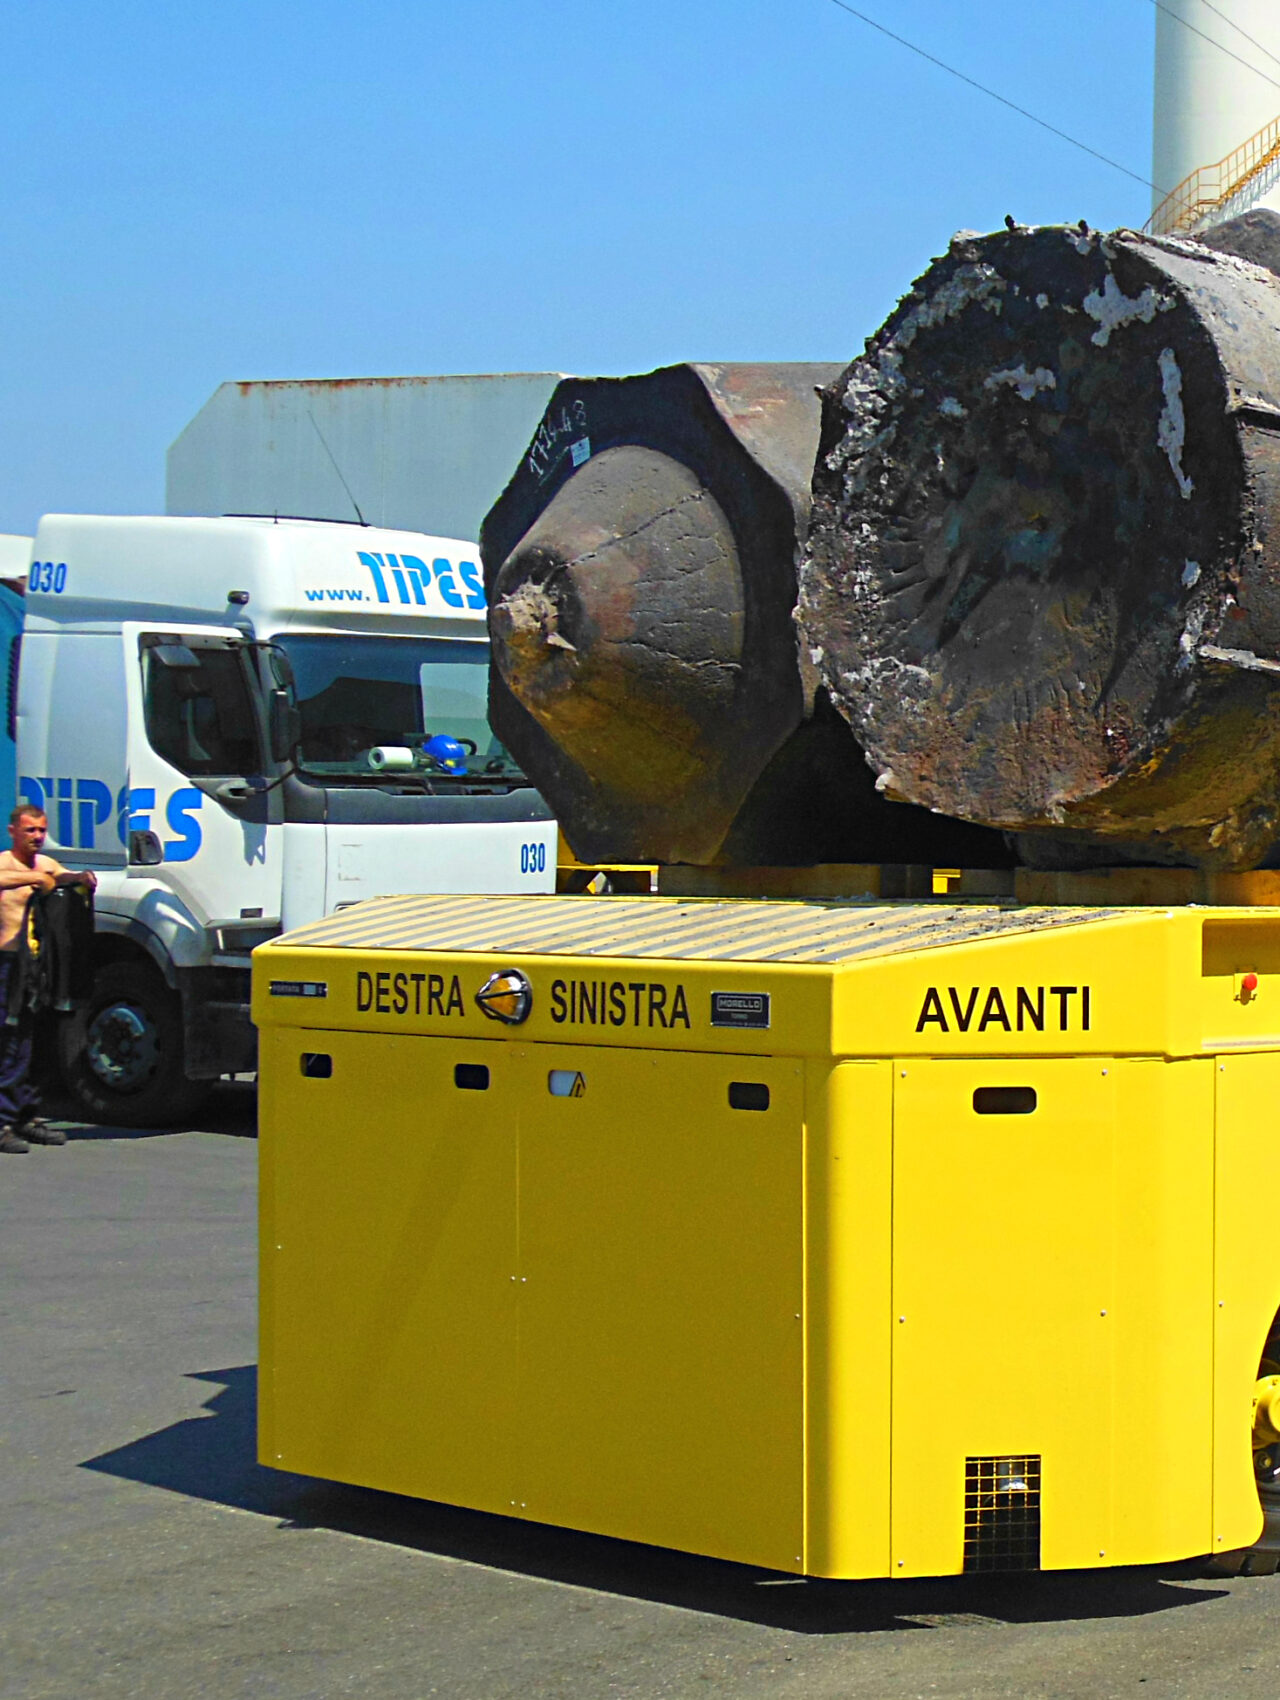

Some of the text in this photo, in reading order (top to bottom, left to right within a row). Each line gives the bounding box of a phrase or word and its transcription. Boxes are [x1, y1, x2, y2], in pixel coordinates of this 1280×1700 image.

[29, 561, 67, 593] 030
[521, 842, 545, 873] 030
[357, 971, 691, 1029] DESTRA SINISTRA
[915, 986, 1090, 1032] AVANTI
